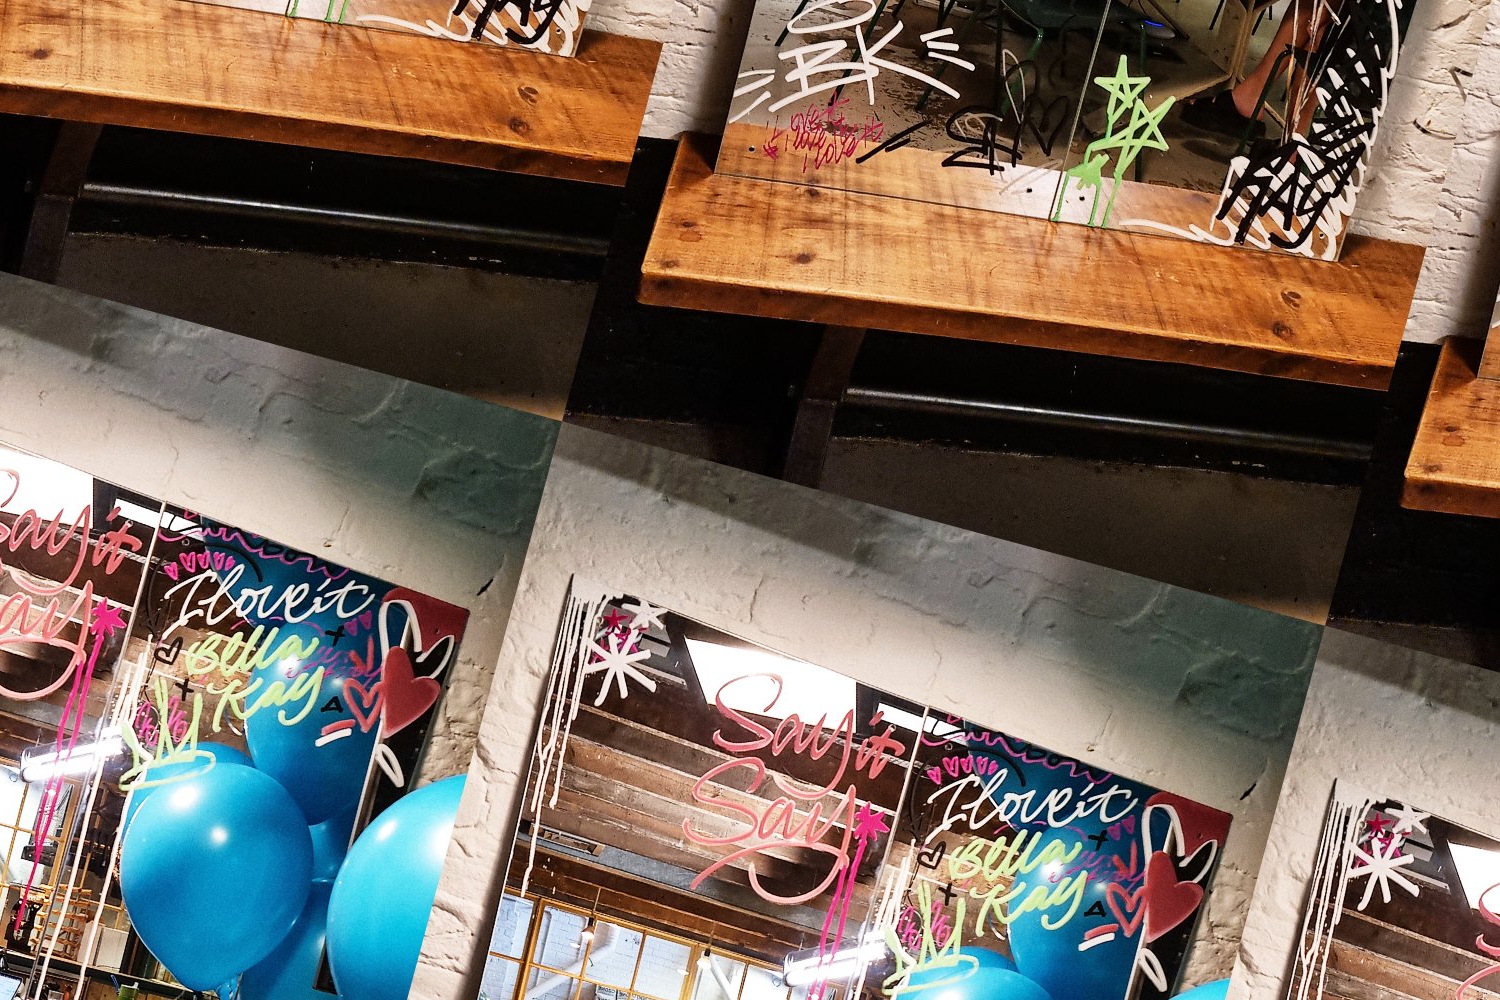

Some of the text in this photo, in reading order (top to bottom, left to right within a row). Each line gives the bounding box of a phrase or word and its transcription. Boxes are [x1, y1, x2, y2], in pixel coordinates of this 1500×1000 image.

[92, 506, 143, 575] it
[184, 624, 320, 677] Bella
[206, 665, 326, 733] Kay
[712, 672, 855, 800] Say
[855, 710, 906, 780] it
[682, 756, 856, 904] Say
[947, 828, 1083, 882] Bella
[969, 870, 1089, 938] Kay
